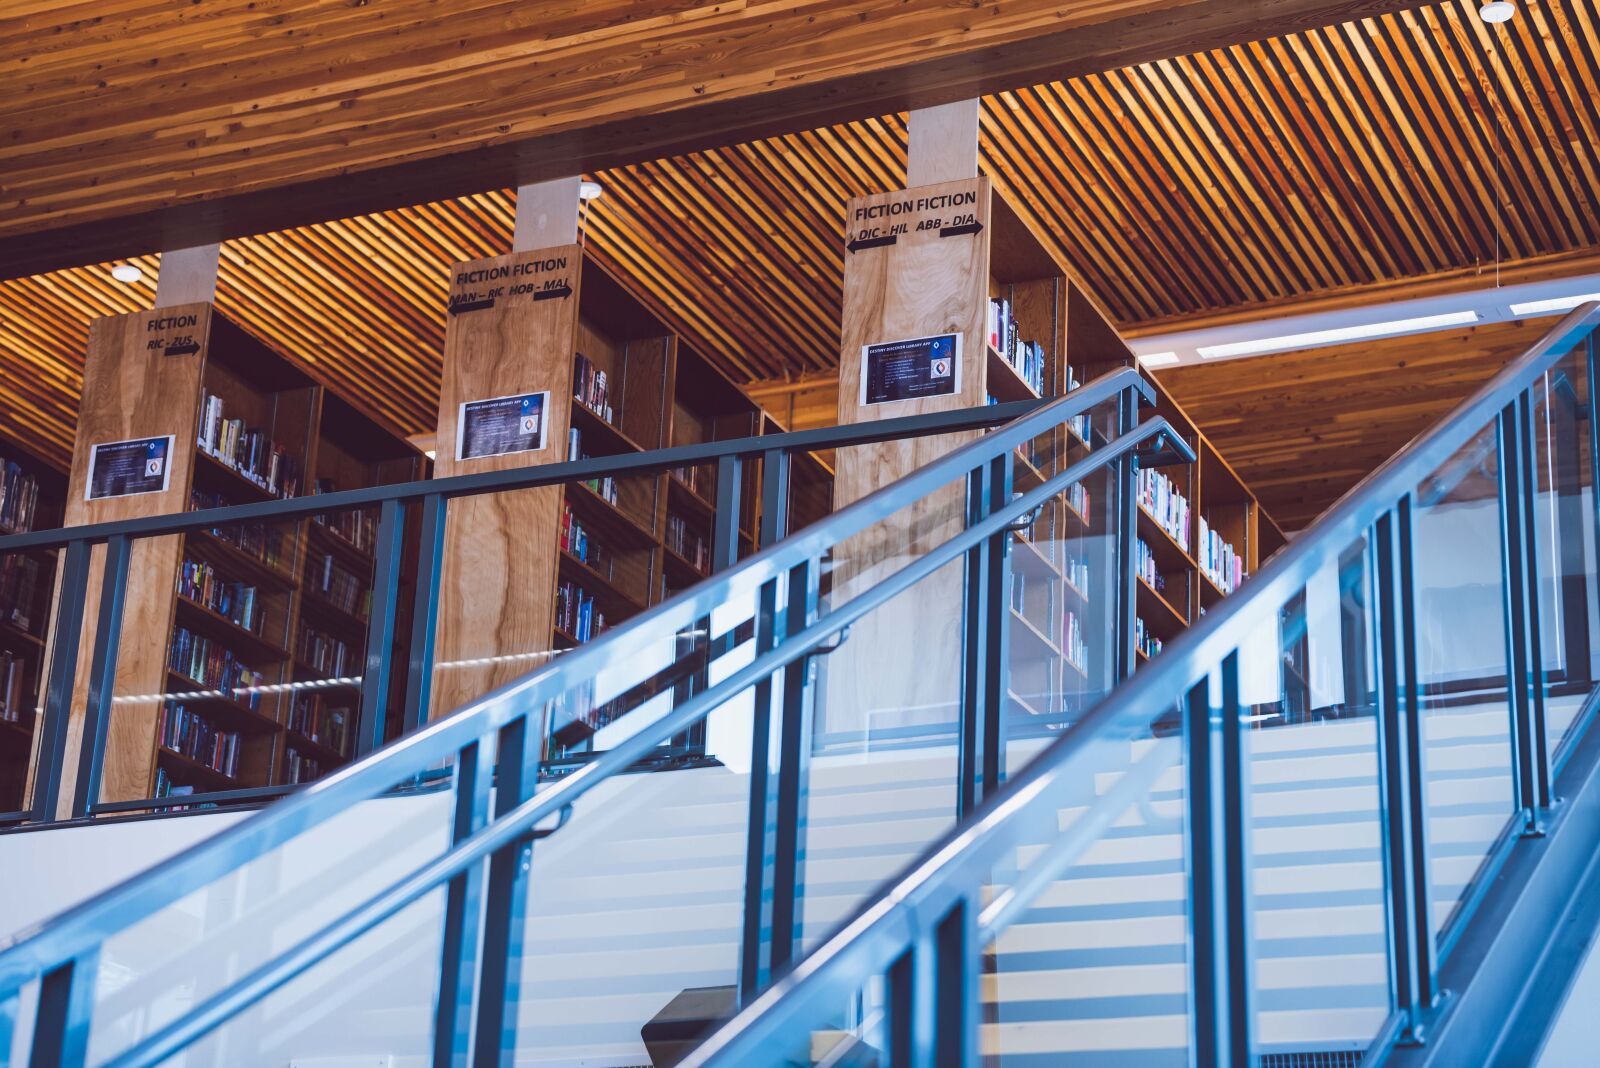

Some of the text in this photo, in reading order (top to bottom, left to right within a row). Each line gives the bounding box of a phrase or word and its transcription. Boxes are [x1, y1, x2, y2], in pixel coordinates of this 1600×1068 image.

[856, 191, 976, 220] FICTION FICTION
[916, 219, 941, 232] ABB
[952, 213, 974, 227] DIA
[859, 228, 880, 240] DIC
[890, 223, 908, 236] HIL
[457, 257, 567, 284] FICTION FICTION
[449, 292, 476, 304] MAN
[488, 287, 504, 298] RIC
[509, 283, 533, 295] HOB
[147, 315, 197, 331] FICTION
[147, 338, 164, 350] RIC
[171, 335, 193, 347] ZUS
